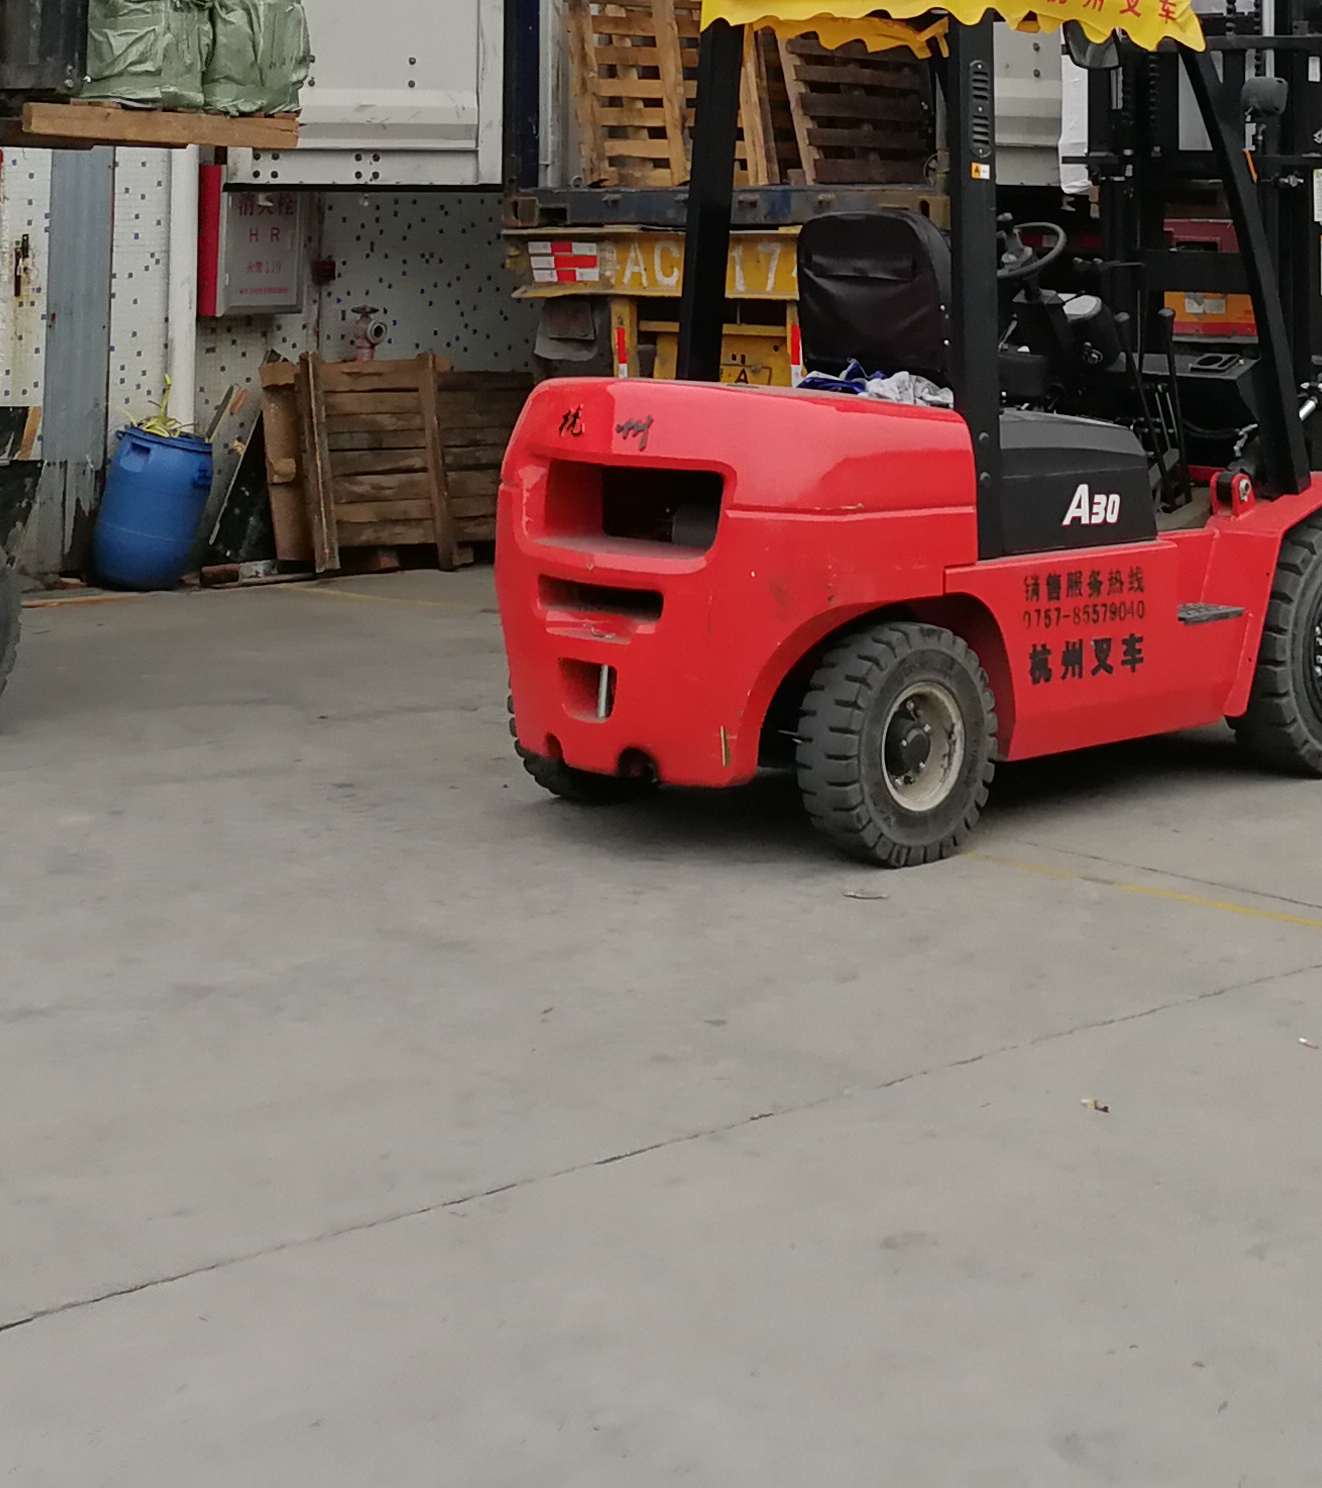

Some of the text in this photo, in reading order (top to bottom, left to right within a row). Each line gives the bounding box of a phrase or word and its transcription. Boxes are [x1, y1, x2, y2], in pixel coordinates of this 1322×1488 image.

[1061, 483, 1121, 526] A30
[1023, 566, 1145, 603] 销售服务热线
[1029, 633, 1145, 685] 杭州叉车
